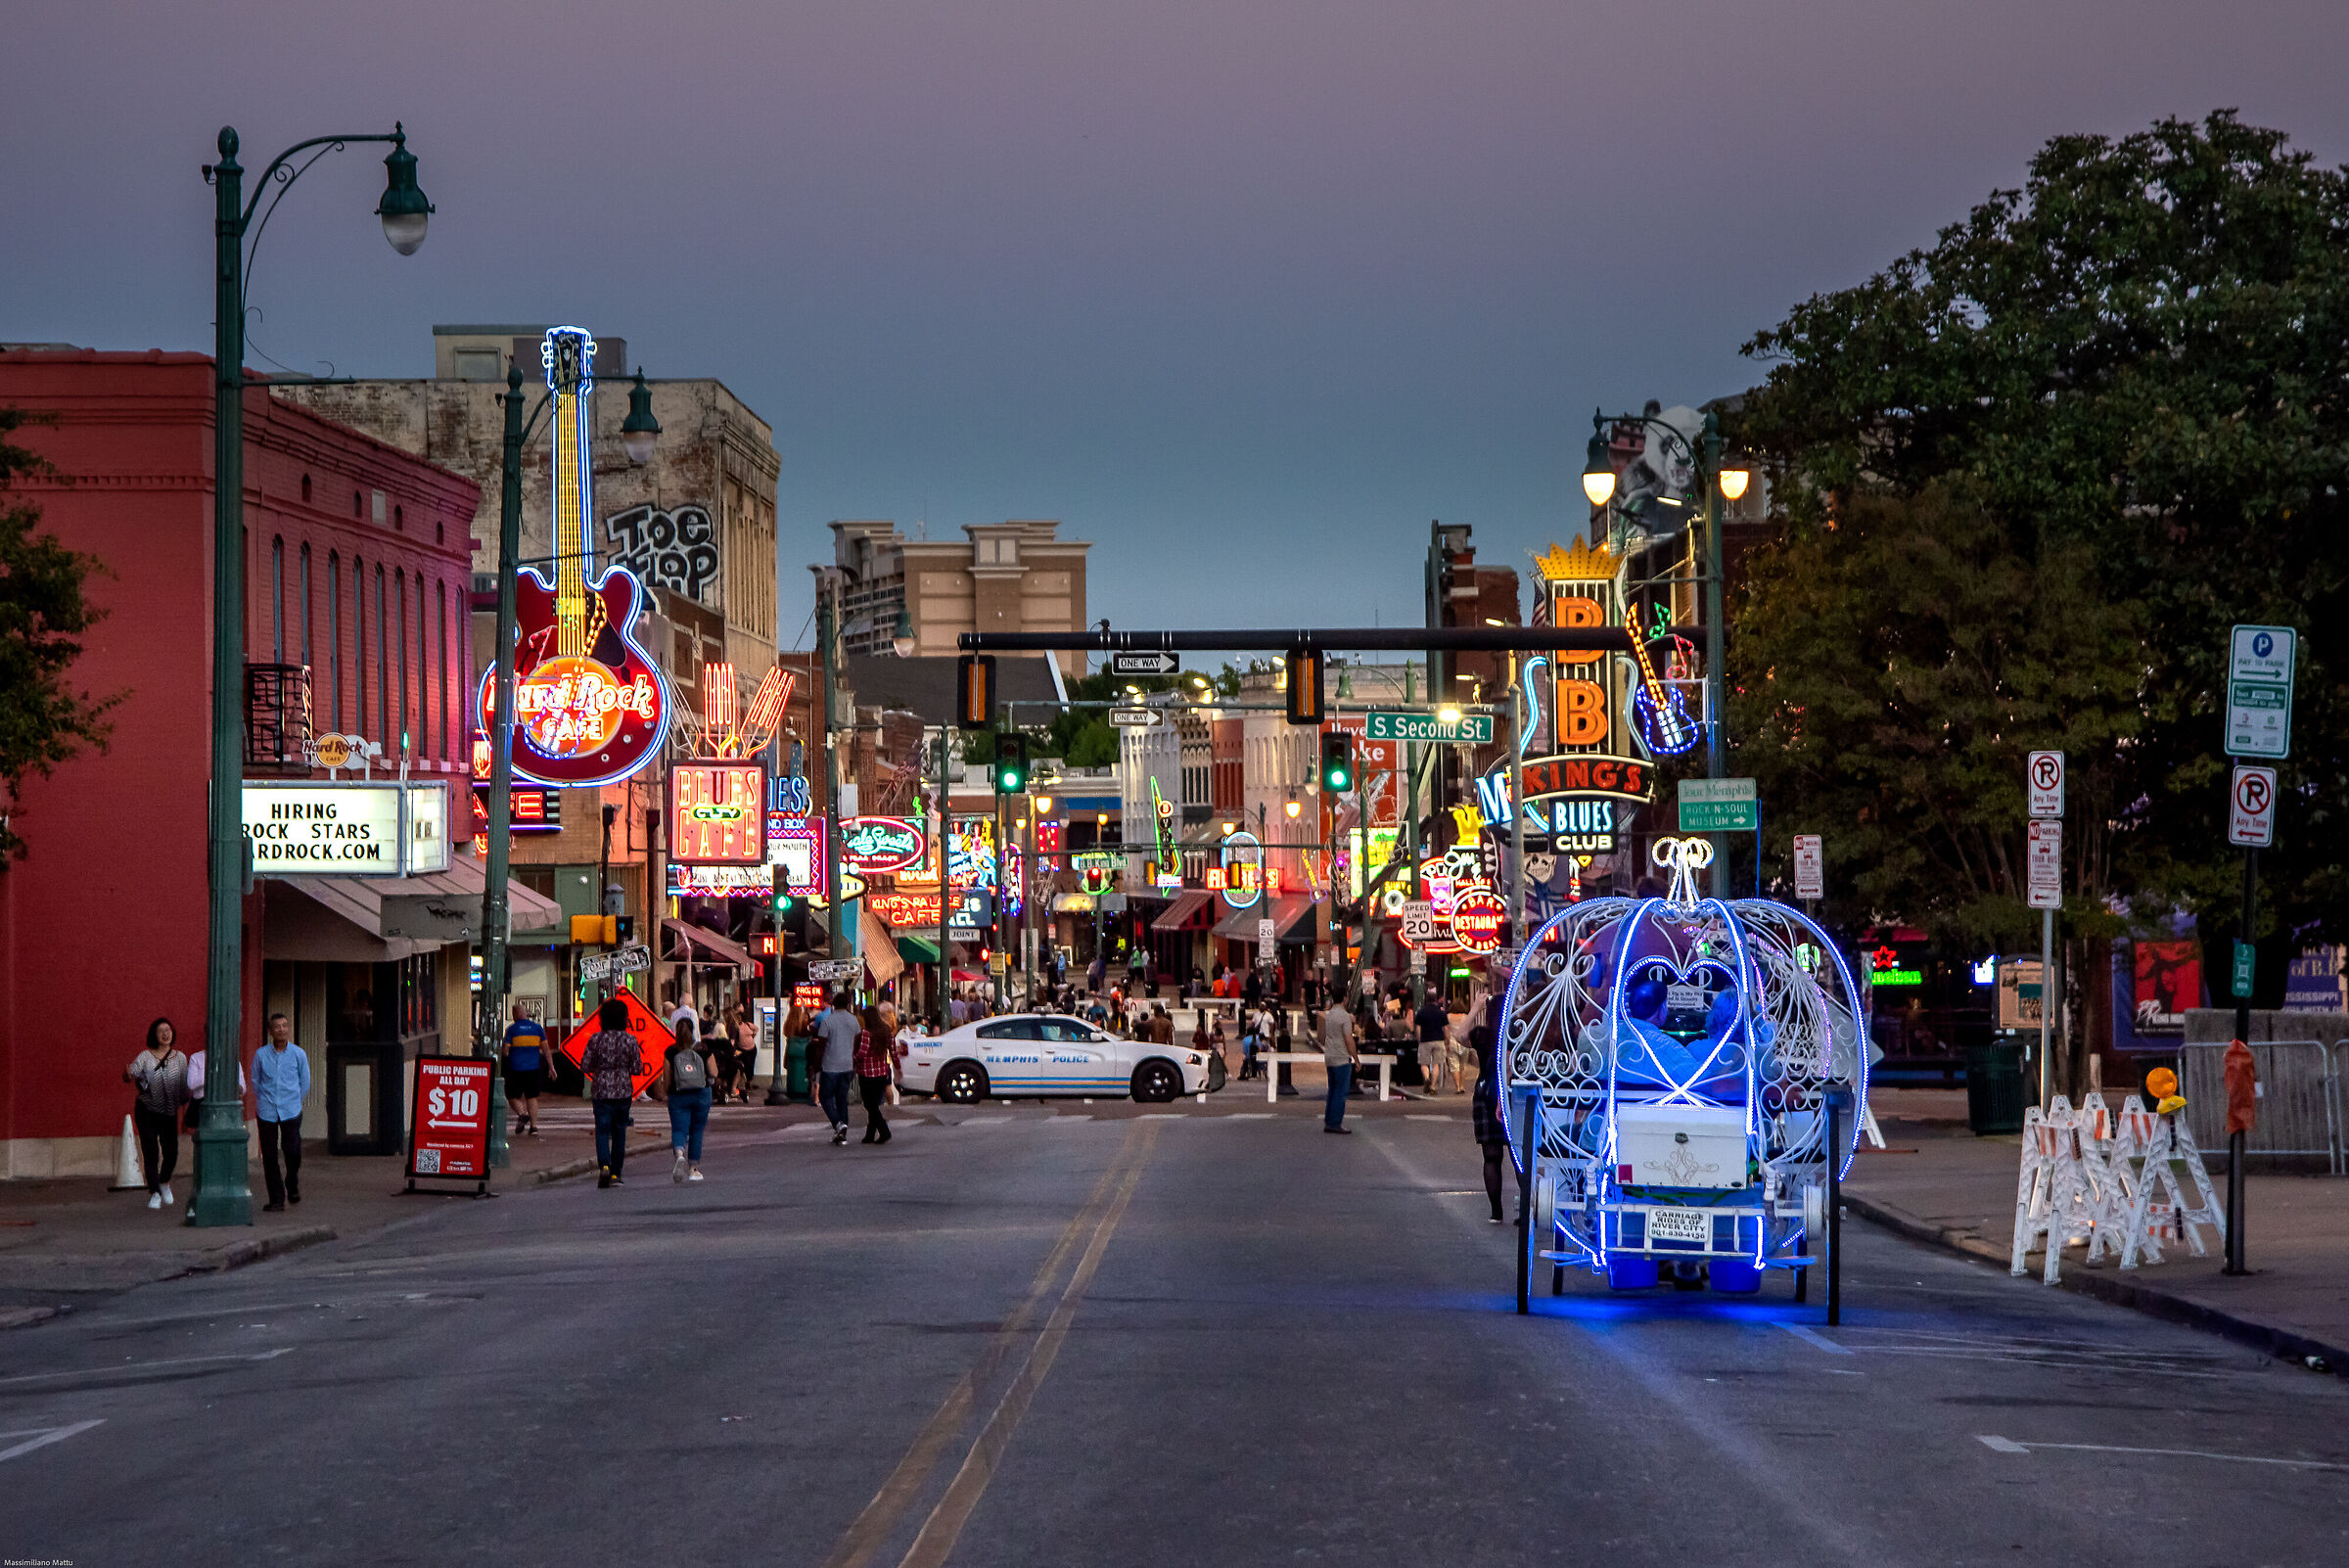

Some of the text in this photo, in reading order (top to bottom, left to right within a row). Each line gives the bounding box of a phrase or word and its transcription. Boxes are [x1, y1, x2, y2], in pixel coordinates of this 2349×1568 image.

[1121, 659, 1161, 668] ONE WAY
[574, 672, 654, 718] Rock
[1556, 679, 1608, 745] B
[1374, 716, 1486, 740] S. Second St.
[302, 740, 362, 756] Hard Rock
[1522, 761, 1641, 794] KING'S
[677, 770, 759, 807] BLUES
[1706, 782, 1752, 800] Memphis
[2033, 794, 2045, 804] Any
[271, 804, 338, 818] HIRING
[1555, 801, 1613, 832] BLUES
[784, 819, 806, 829] BOX
[1688, 815, 1729, 826] MUSEUM
[2235, 816, 2249, 828] Any
[242, 824, 370, 839] ROCK STARS
[678, 808, 756, 856] CAFE
[1556, 835, 1613, 852] CLUB
[252, 844, 381, 859] RDROCK.COM
[1468, 895, 1495, 908] BAR
[892, 910, 941, 925] CAFE
[1406, 921, 1430, 935] 20
[423, 1065, 487, 1077] PUBLIC PARKING
[439, 1076, 470, 1085] ALL DAY
[429, 1086, 479, 1117] $10
[1655, 1211, 1704, 1221] CARRIAGE
